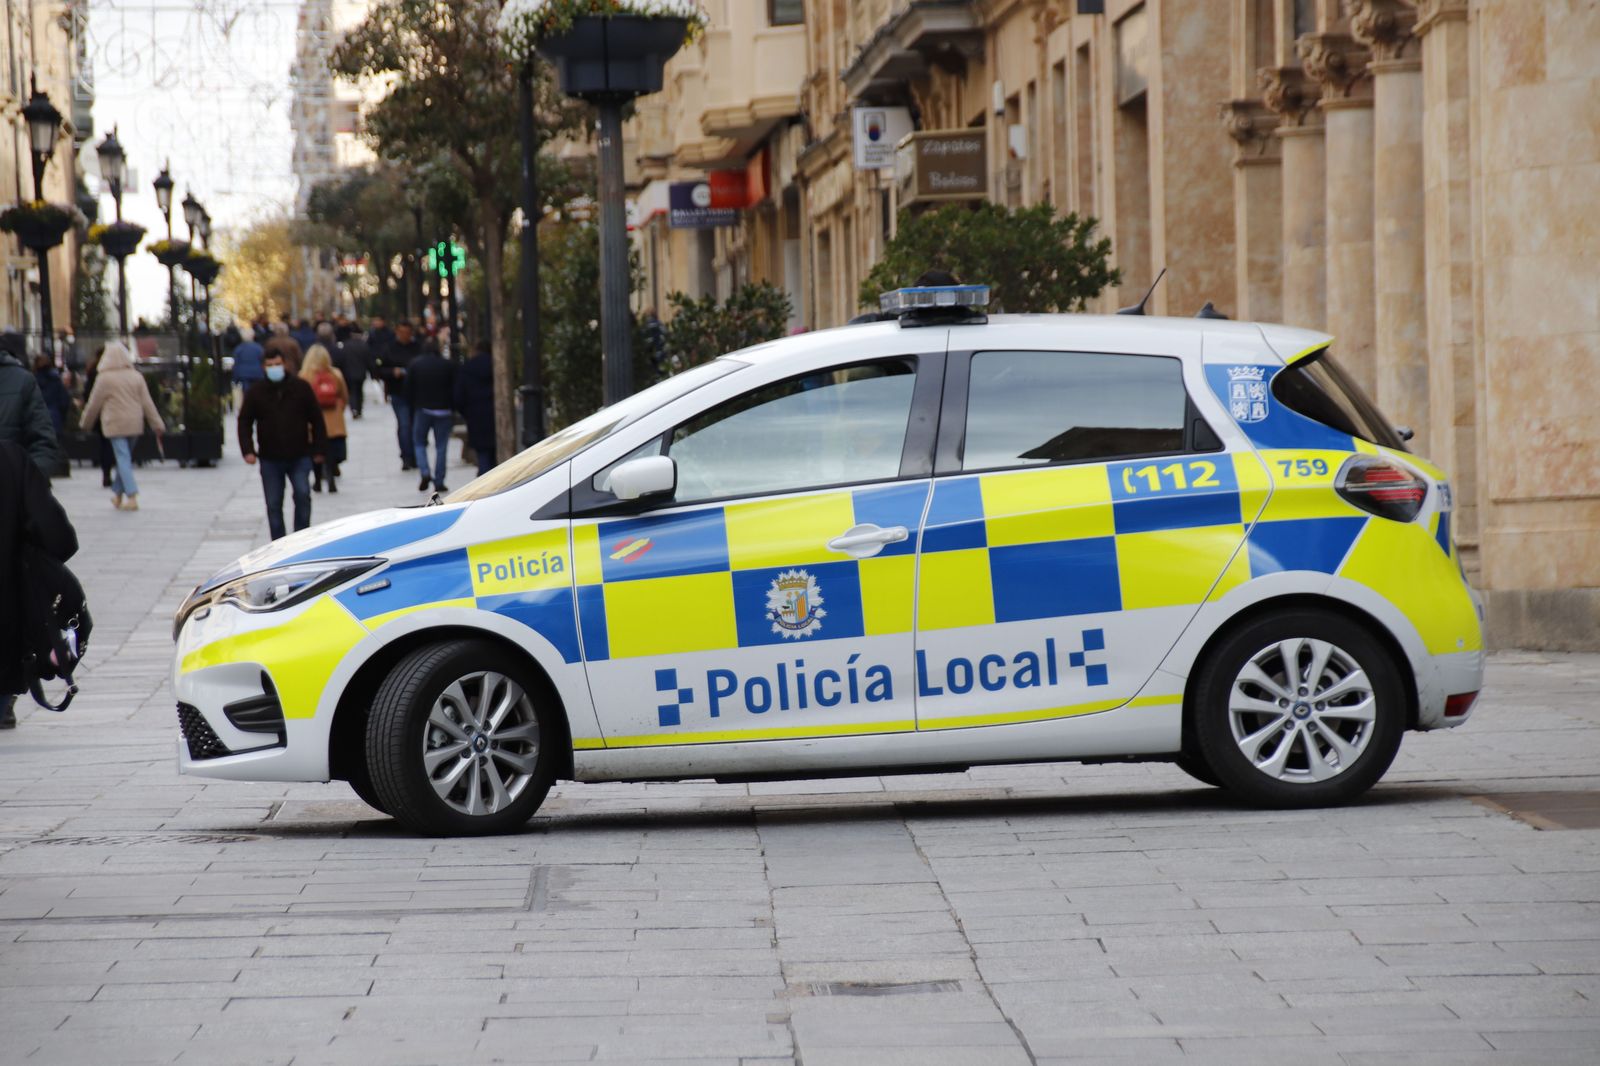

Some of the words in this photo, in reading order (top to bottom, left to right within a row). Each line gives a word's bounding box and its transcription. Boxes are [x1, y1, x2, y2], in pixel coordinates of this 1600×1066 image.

[1136, 460, 1220, 492] 112
[1277, 458, 1328, 478] 759
[477, 551, 564, 583] Policía
[706, 653, 894, 718] Policía
[916, 638, 1058, 697] Local
